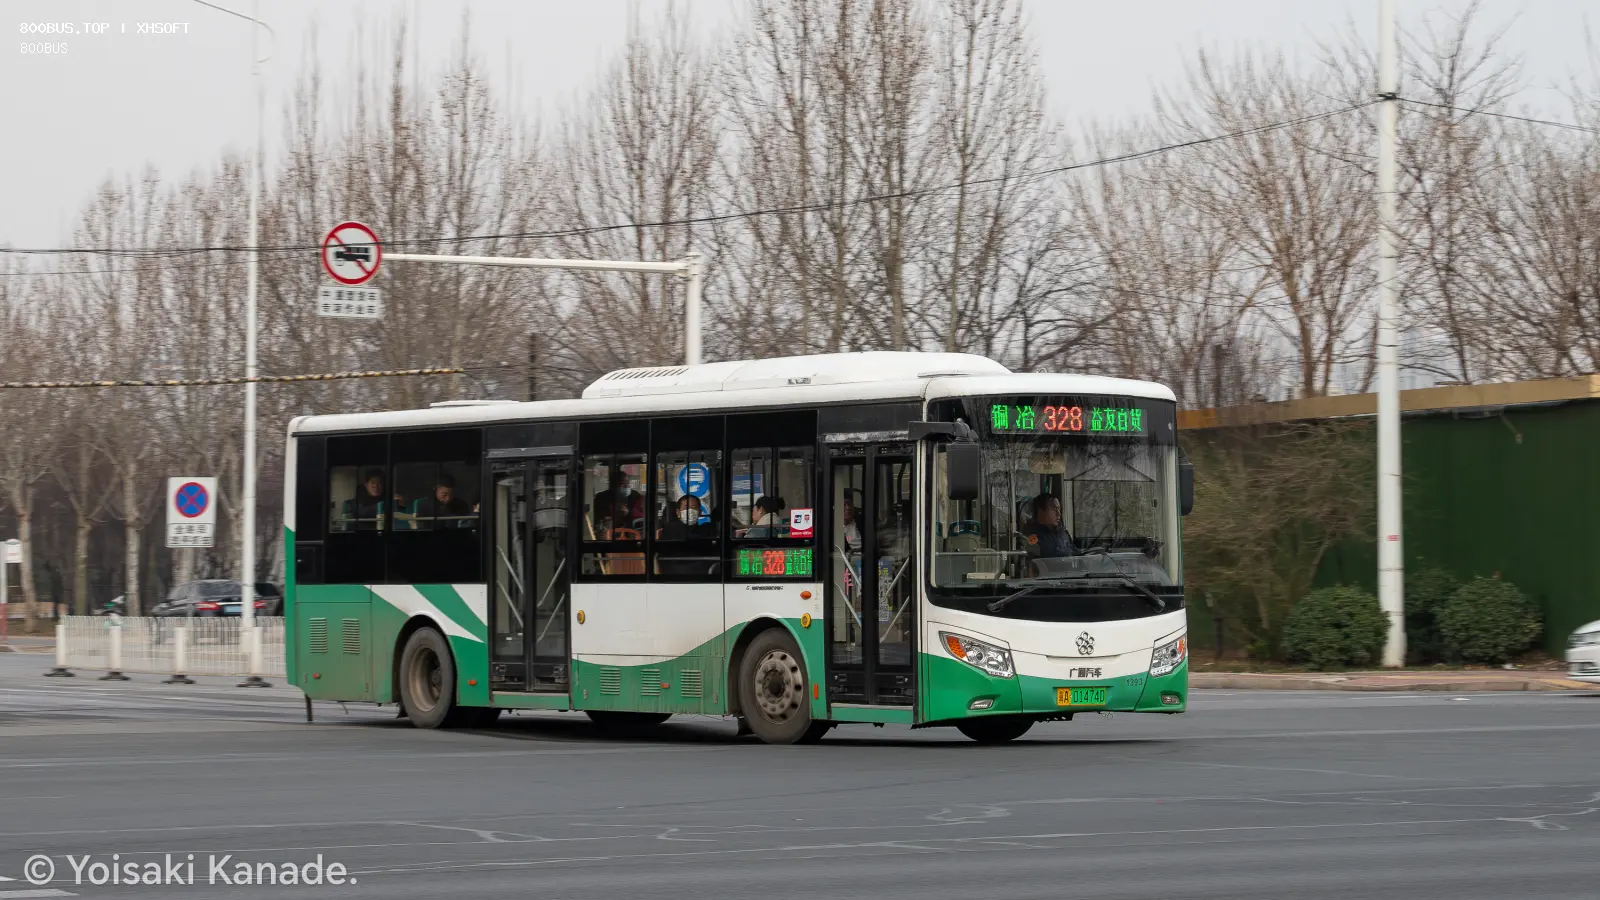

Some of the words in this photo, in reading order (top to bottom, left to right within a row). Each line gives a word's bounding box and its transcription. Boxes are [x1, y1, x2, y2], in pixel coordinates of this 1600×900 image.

[1043, 405, 1083, 431] 328
[1090, 407, 1142, 432] 益友百货
[763, 550, 785, 575] 328
